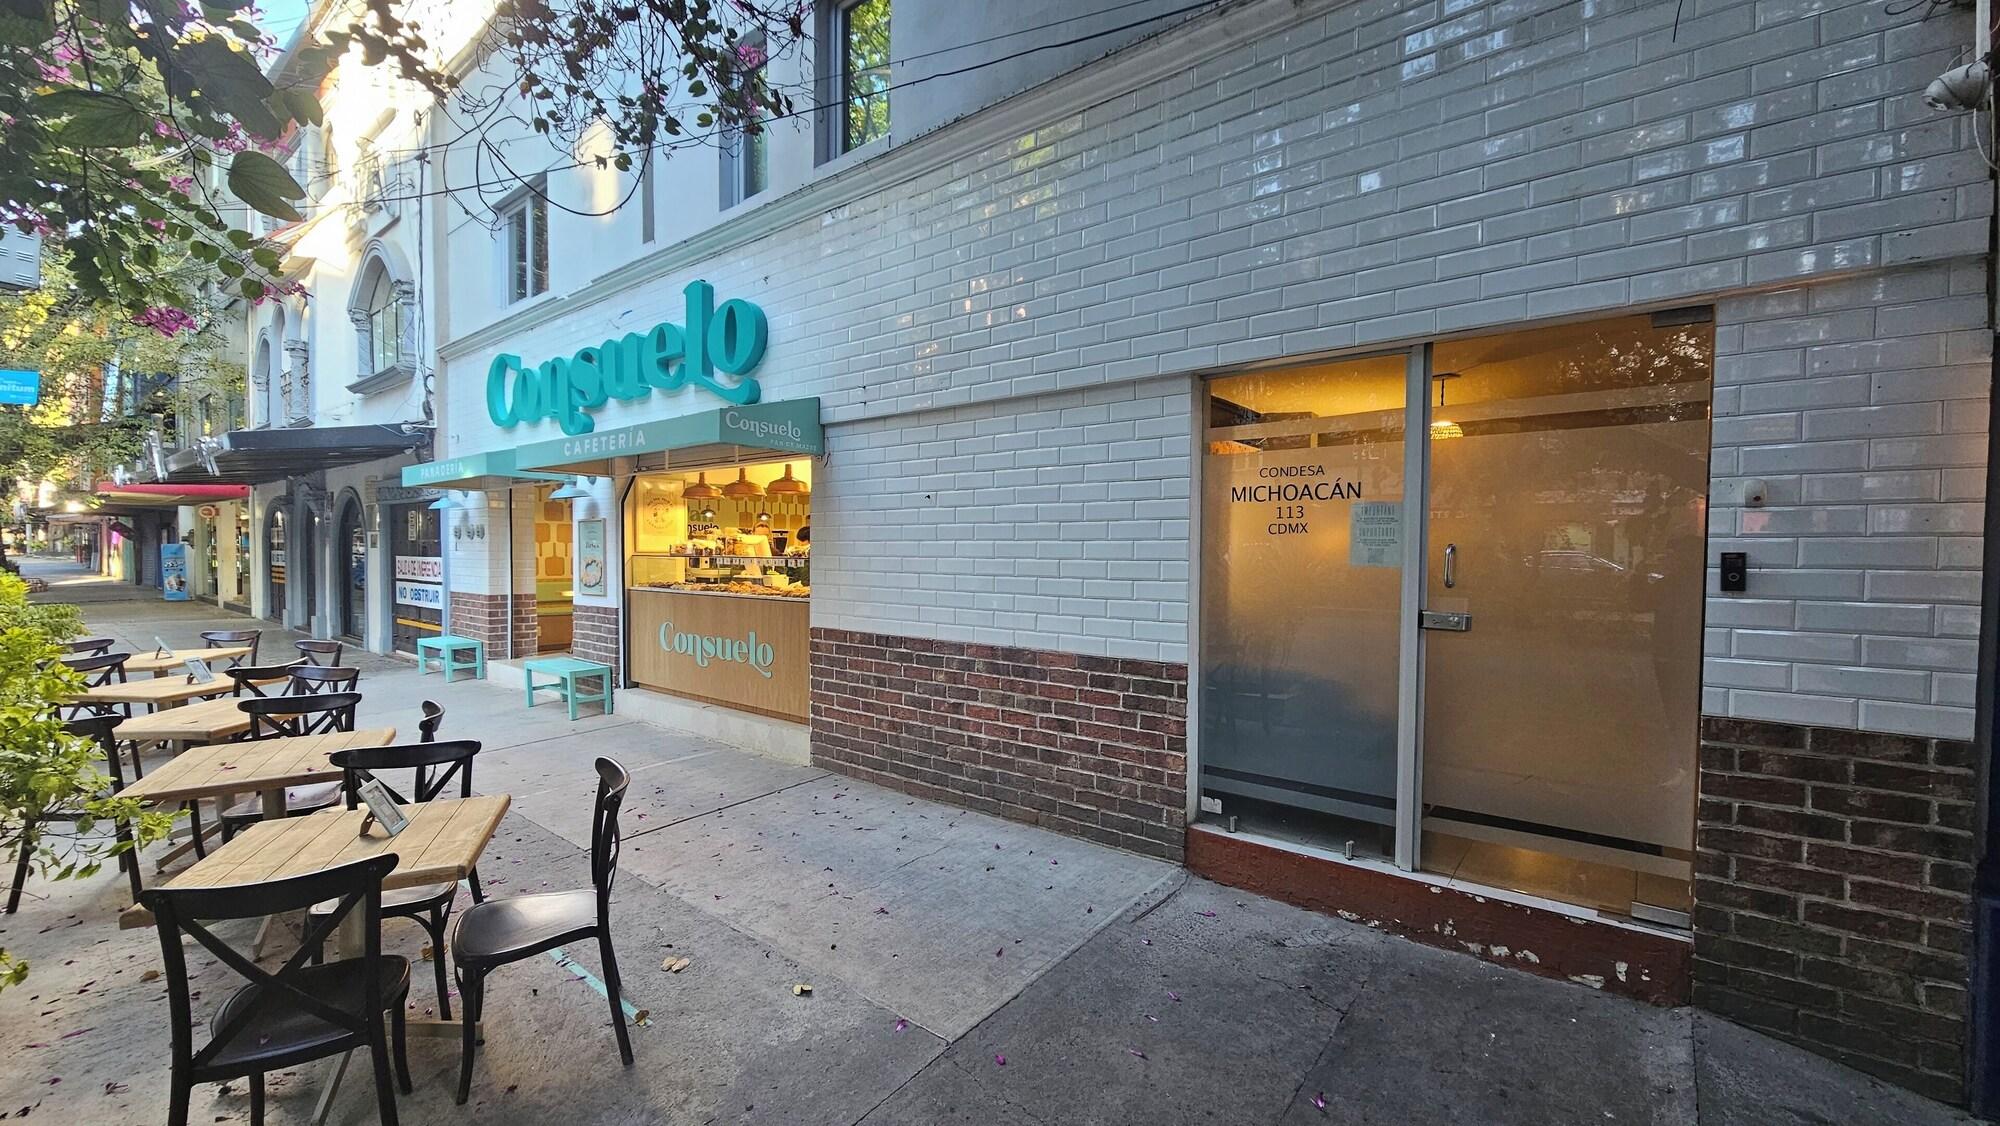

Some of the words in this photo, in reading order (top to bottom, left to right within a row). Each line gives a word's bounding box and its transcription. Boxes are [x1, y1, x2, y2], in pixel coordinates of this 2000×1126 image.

[486, 279, 769, 436] Consuelo
[725, 411, 801, 441] Consuelo
[563, 427, 647, 457] CAFETERÍA
[420, 460, 464, 480] PANADERÍA
[1259, 465, 1325, 478] CONDESA
[1231, 477, 1362, 503] MICHOACÁN
[1276, 505, 1304, 519] 113
[1268, 522, 1309, 535] CDMX
[399, 586, 407, 600] NO
[409, 587, 440, 604] OBSTRUIR
[658, 621, 775, 679] Consuelo
